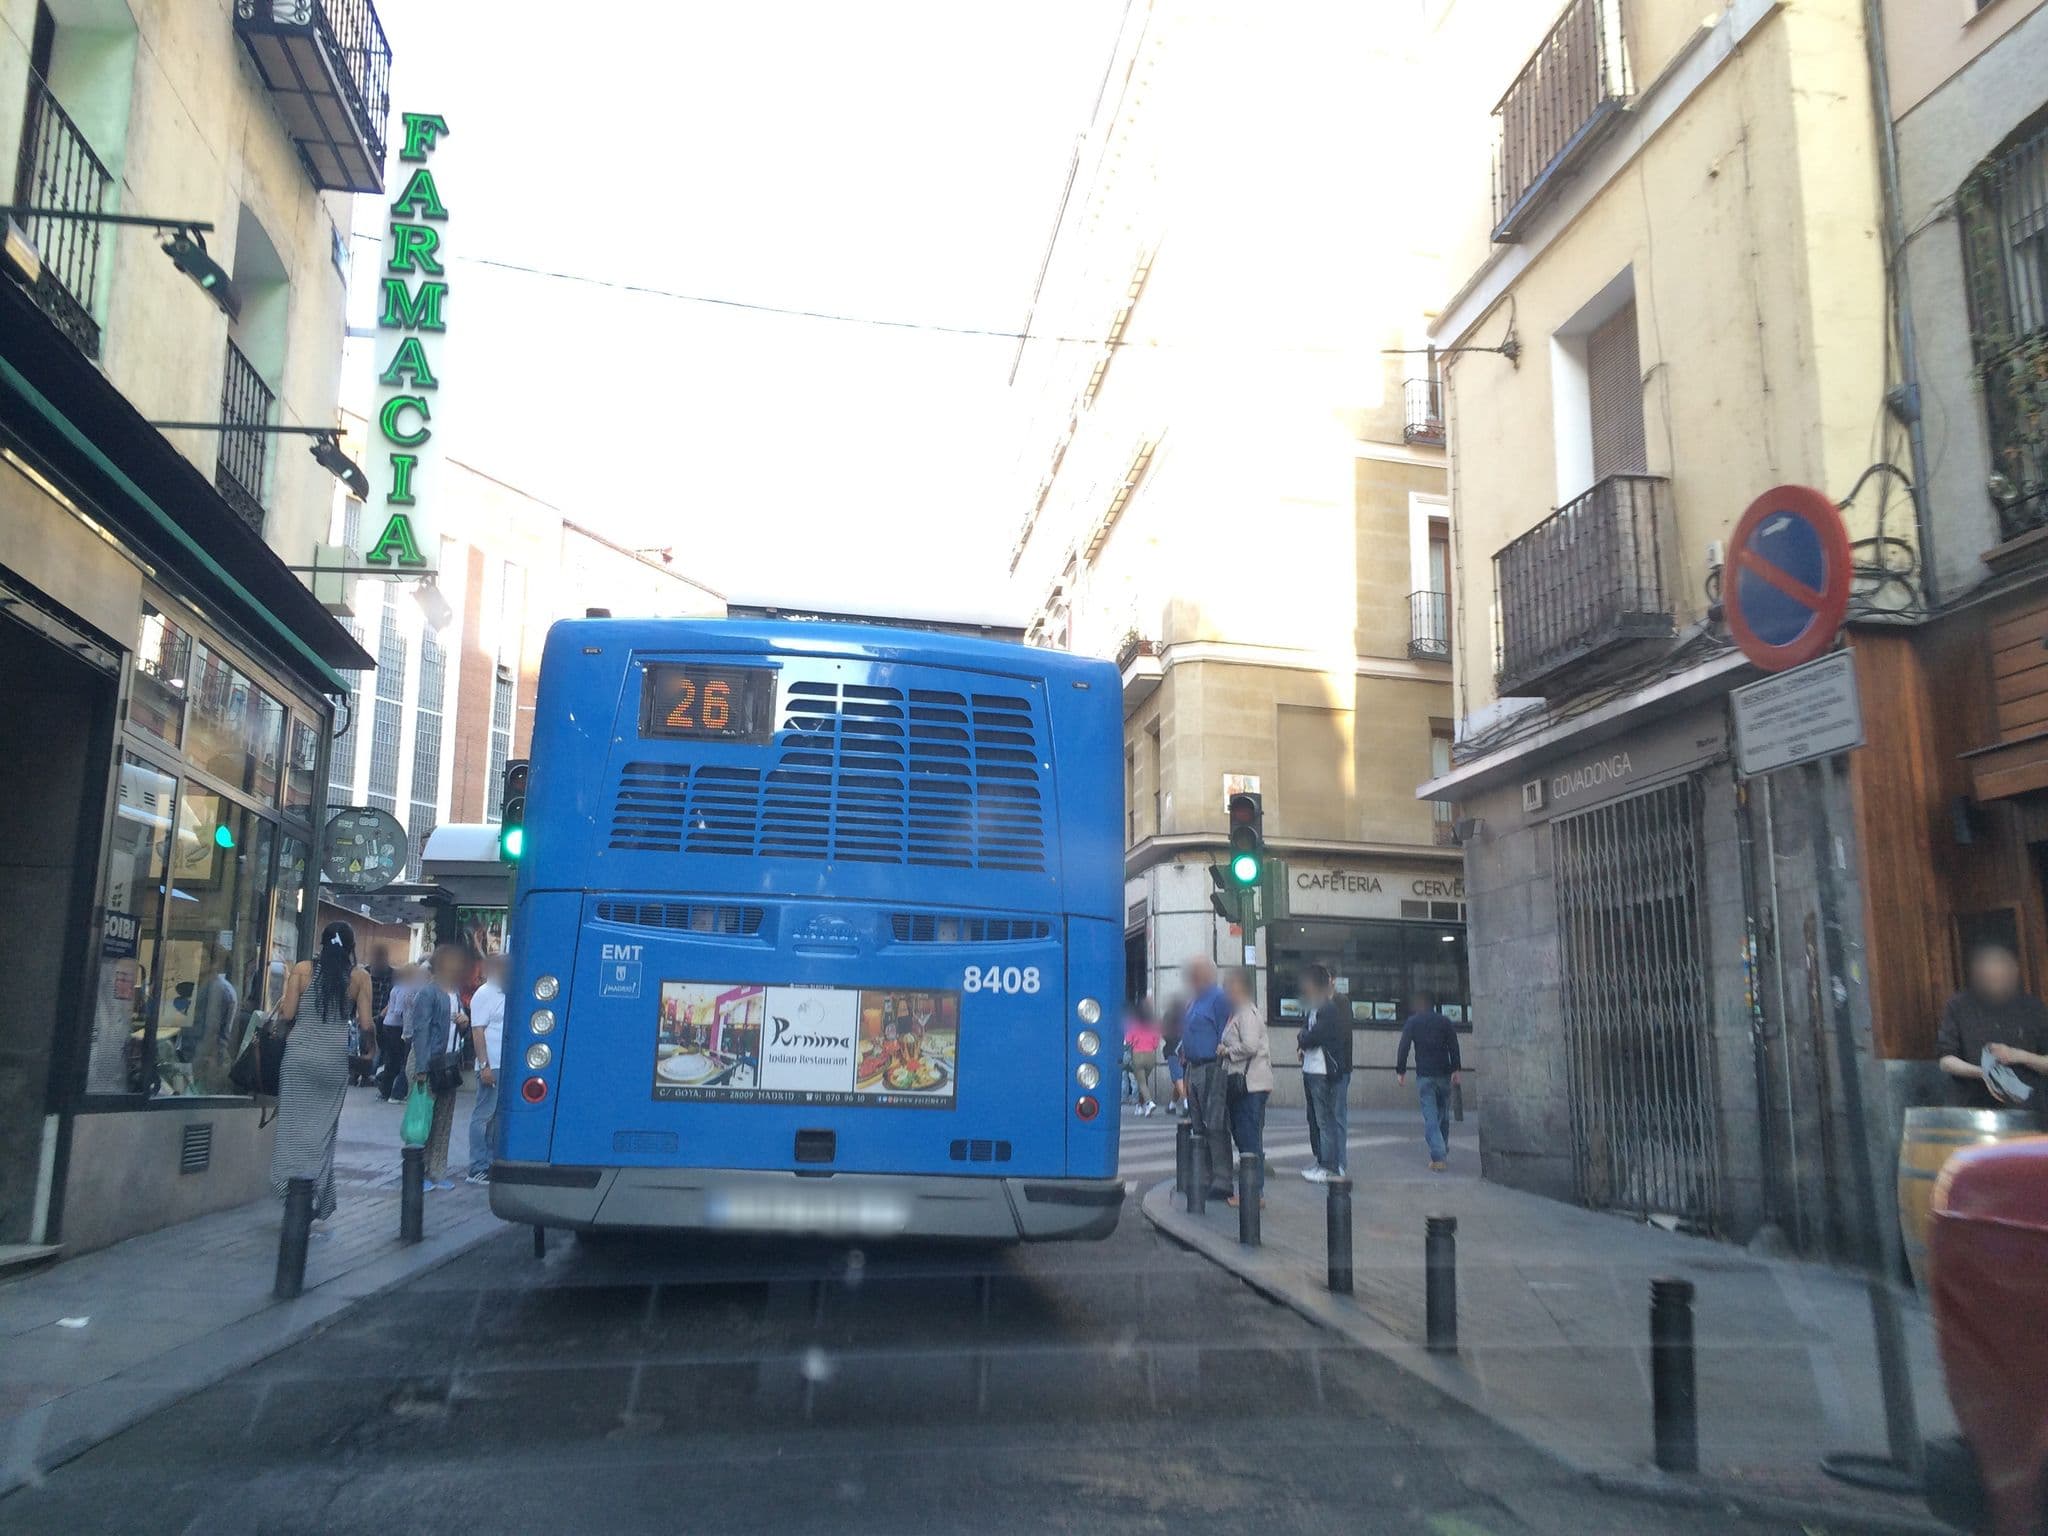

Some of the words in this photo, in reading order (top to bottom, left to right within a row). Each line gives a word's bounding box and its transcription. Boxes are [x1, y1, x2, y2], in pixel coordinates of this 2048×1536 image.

[366, 112, 450, 567] FARMACIA
[666, 679, 731, 729] 26
[1553, 752, 1632, 799] COVADONGA
[1296, 873, 1383, 893] CAFETERIA
[1412, 880, 1466, 898] CERVE
[602, 944, 644, 961] EMT
[963, 965, 1041, 994] 8408
[770, 1015, 850, 1049] Purnima
[768, 1053, 798, 1065] Indian
[800, 1054, 848, 1066] Restaurant
[759, 1091, 795, 1101] MADRID
